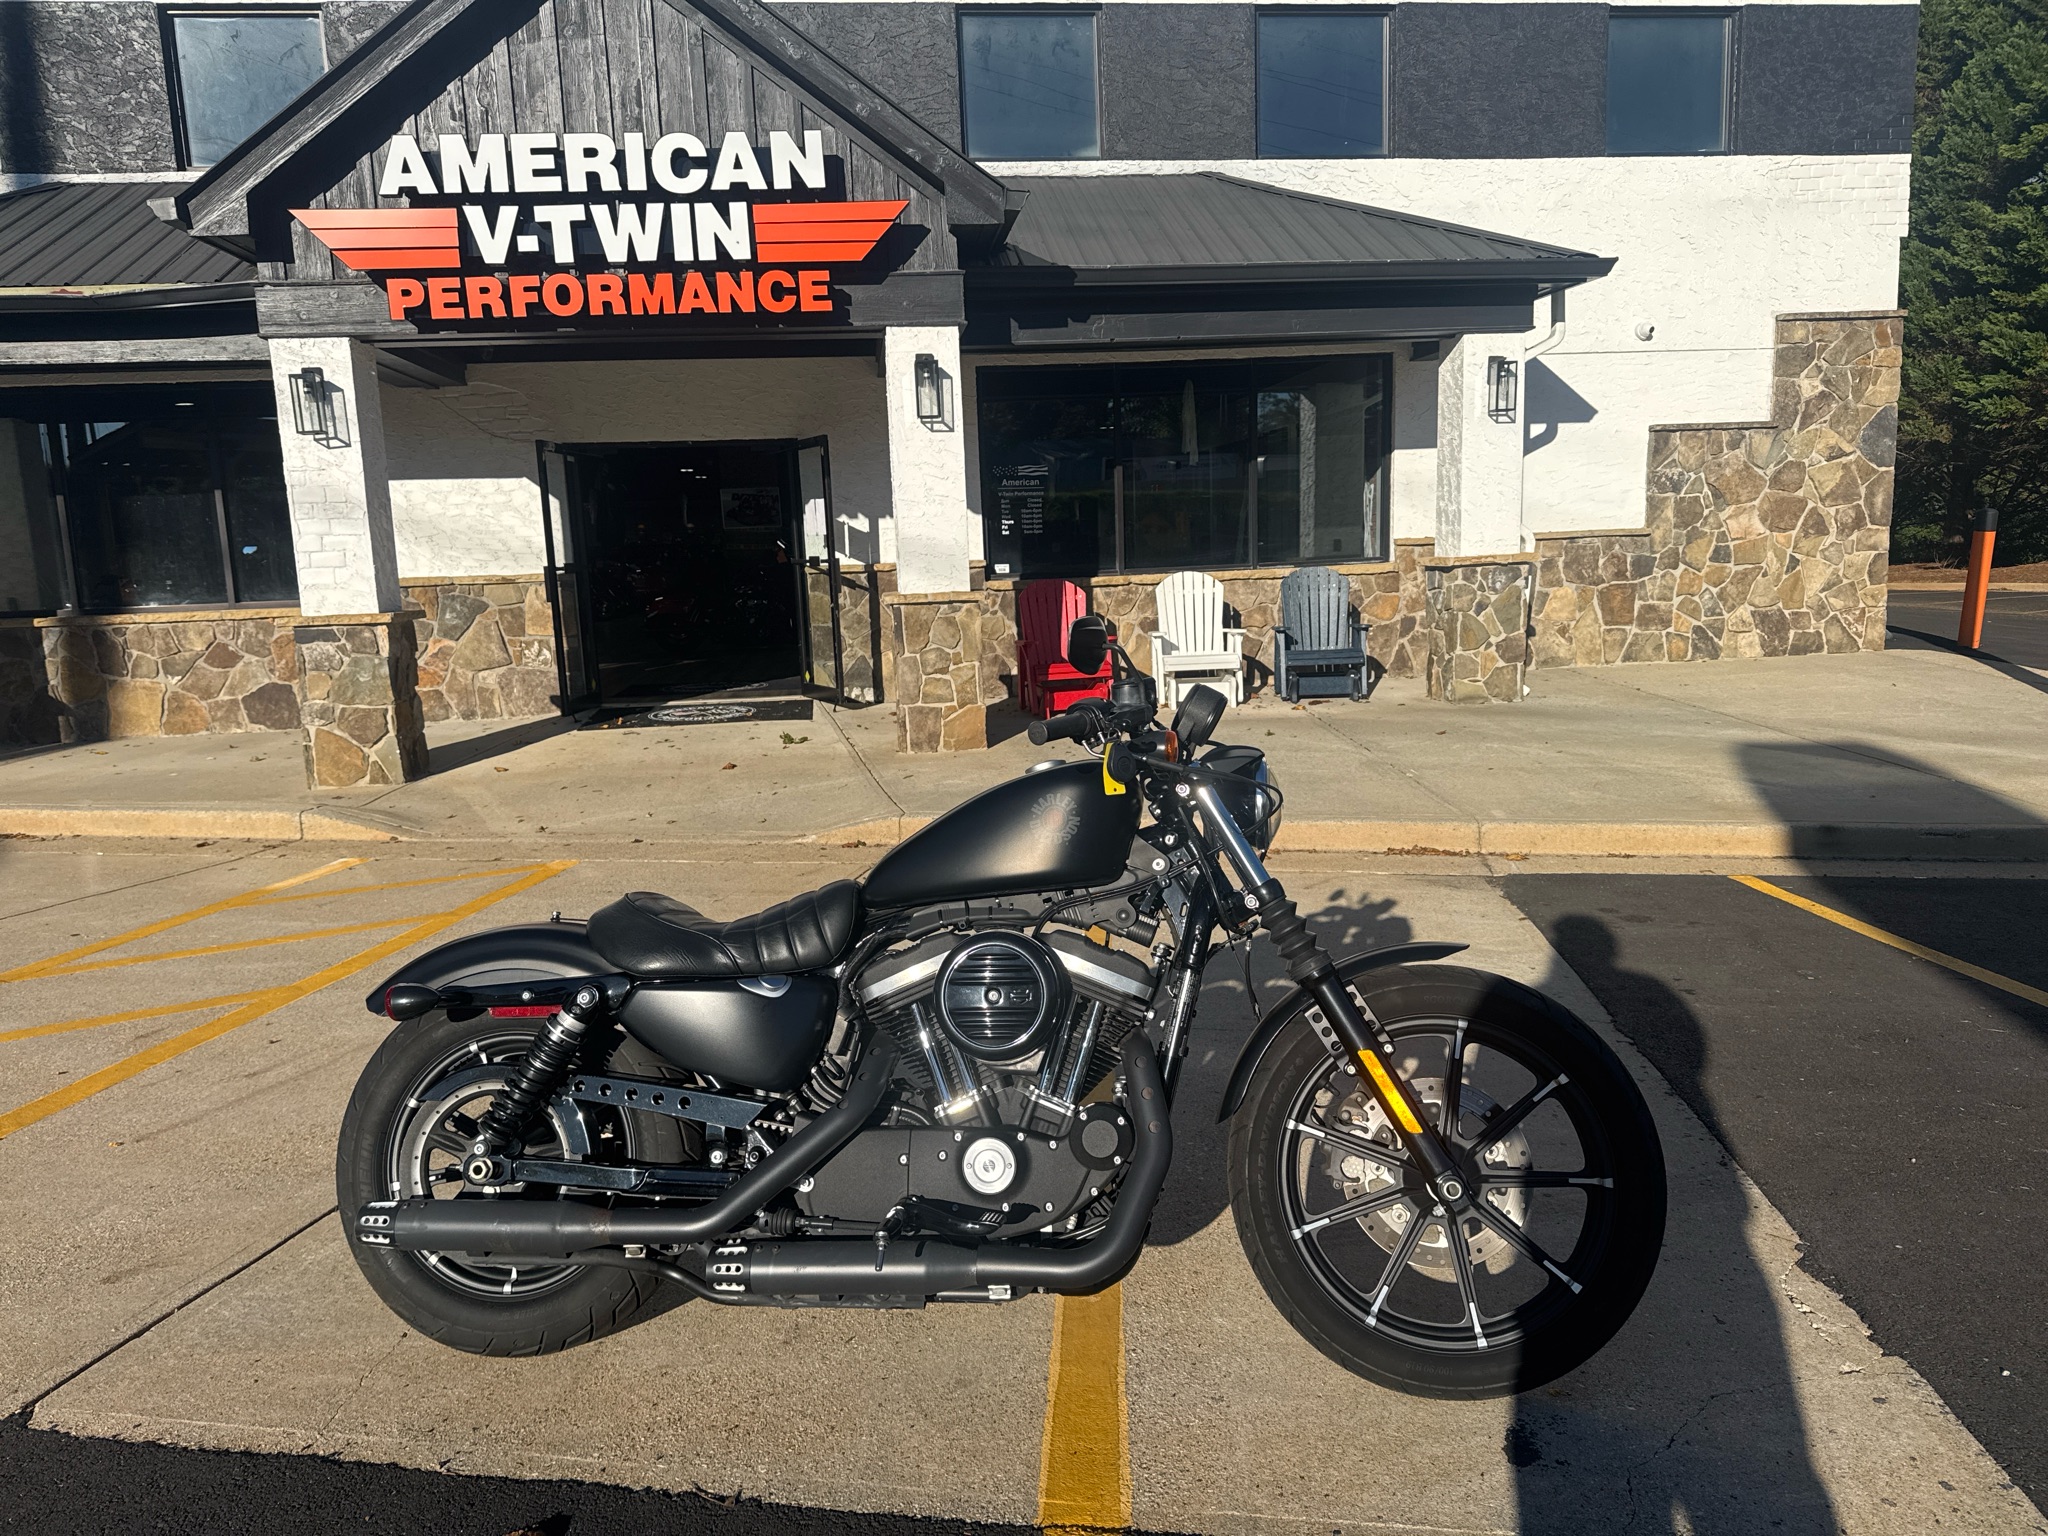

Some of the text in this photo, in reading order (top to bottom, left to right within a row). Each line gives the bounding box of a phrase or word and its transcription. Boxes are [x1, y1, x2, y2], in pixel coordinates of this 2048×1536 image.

[379, 130, 826, 196] AMERICAN
[462, 201, 752, 265] V-TWIN
[386, 270, 833, 321] PERFORMANCE
[1001, 478, 1040, 486] American
[1031, 793, 1077, 815] HARLEY
